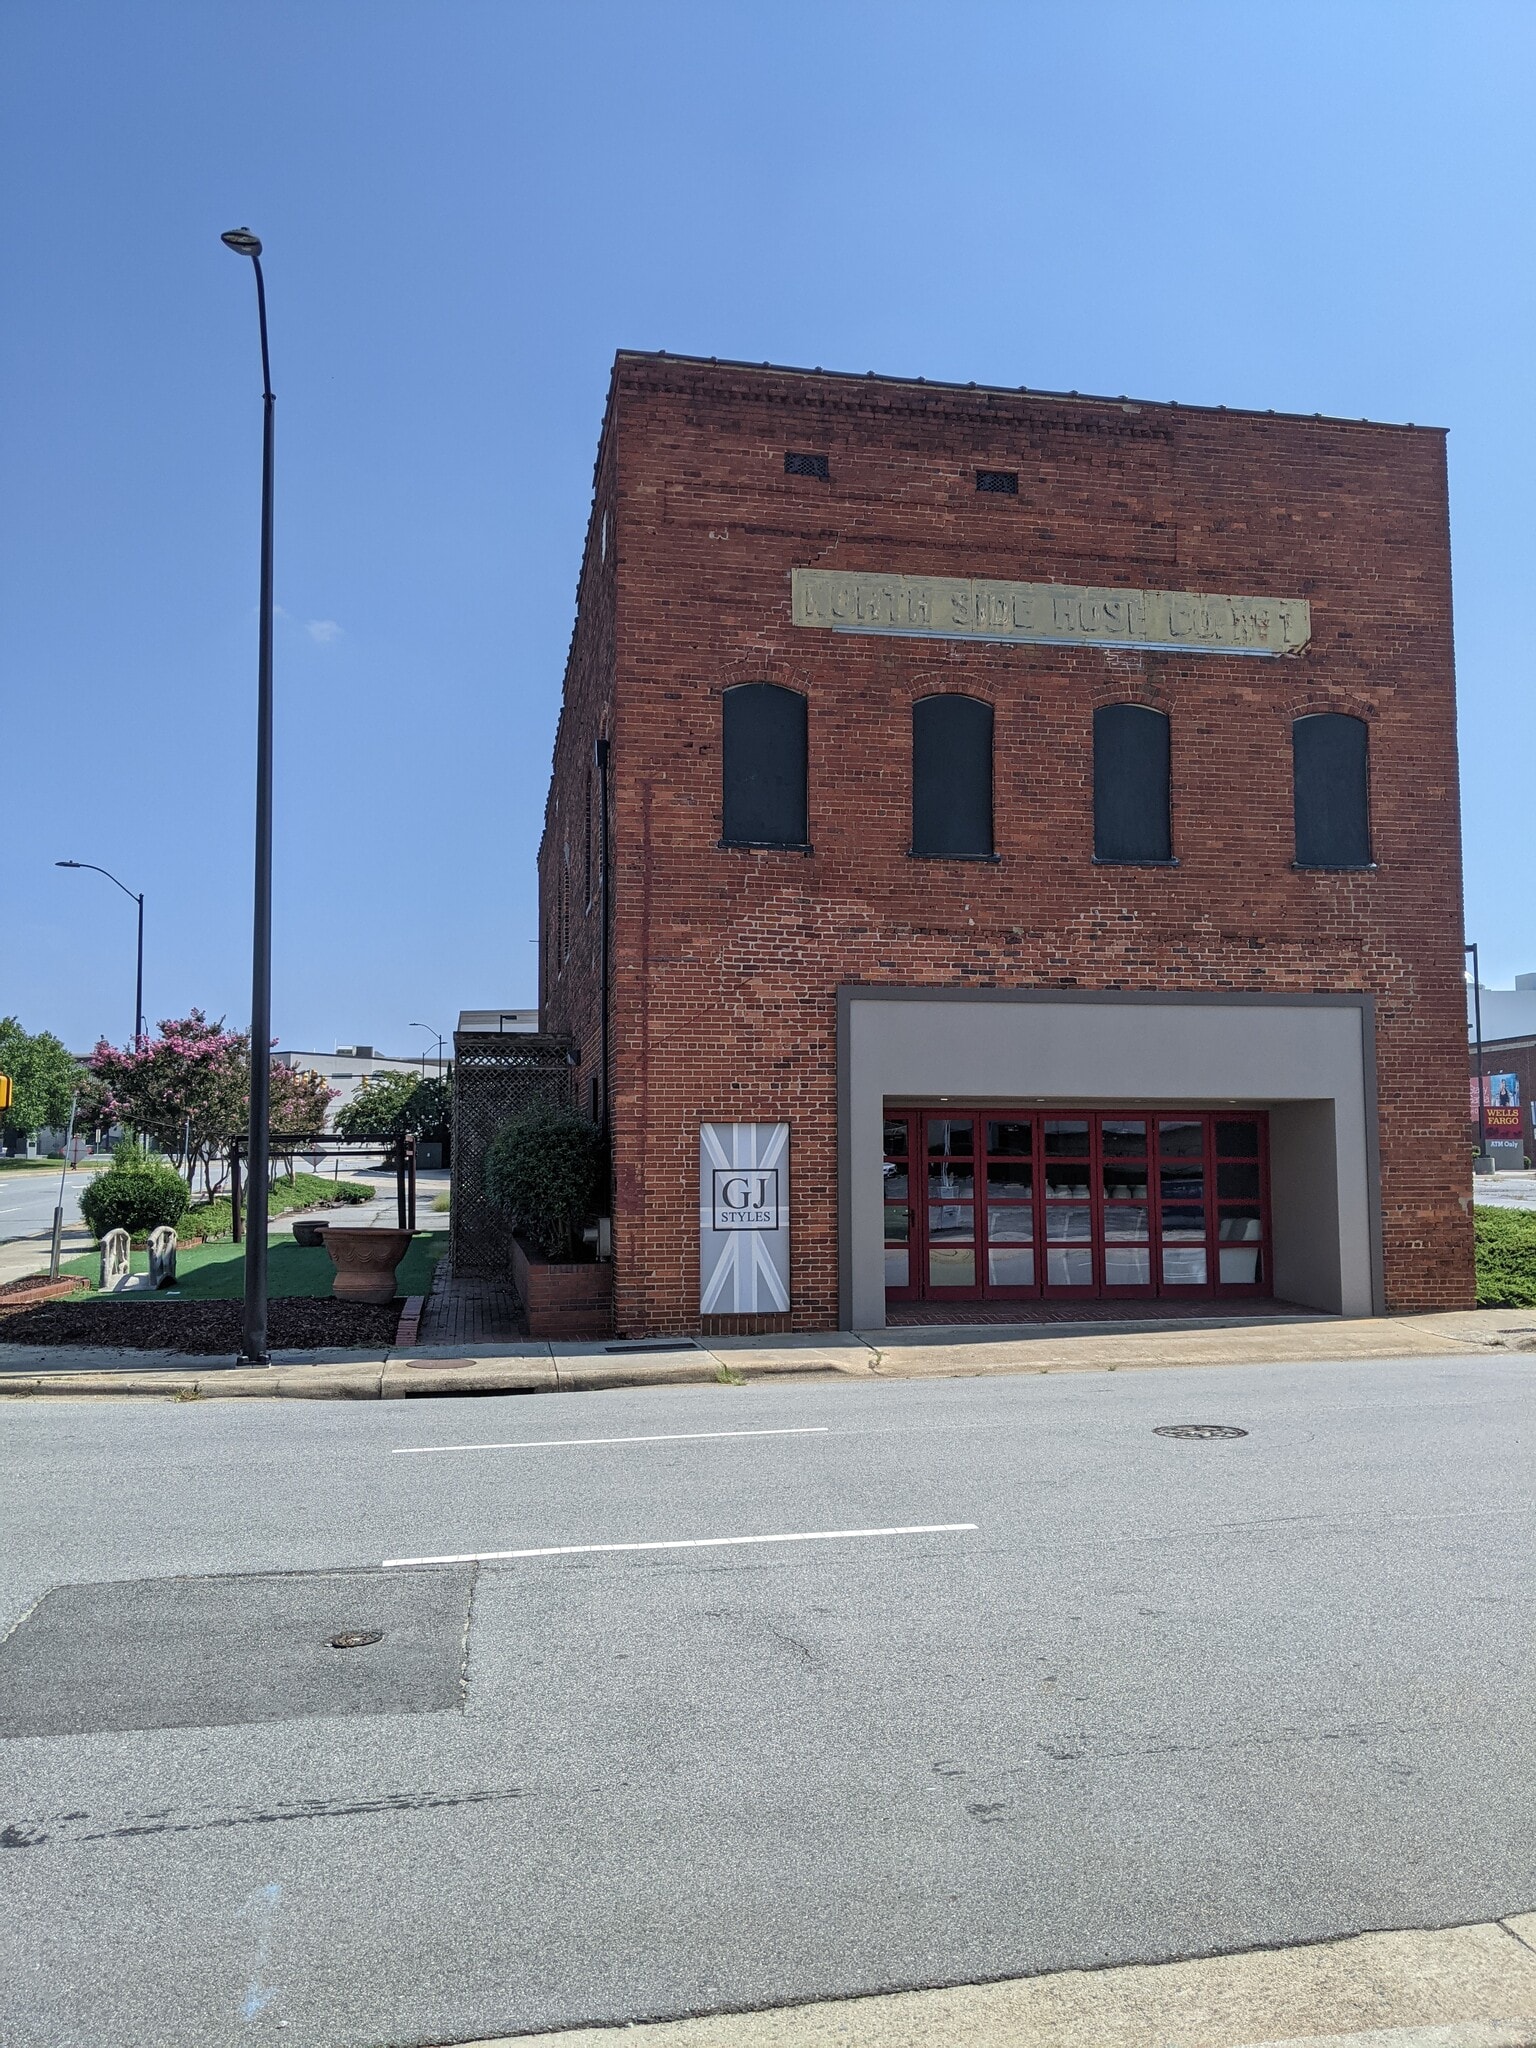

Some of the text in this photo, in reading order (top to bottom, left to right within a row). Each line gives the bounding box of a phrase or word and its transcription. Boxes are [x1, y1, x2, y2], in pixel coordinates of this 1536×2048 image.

[950, 591, 1035, 629] SIDE
[1052, 598, 1147, 635] HOSE
[1487, 1109, 1519, 1117] WELLS
[1488, 1117, 1519, 1125] FARGO
[721, 1177, 769, 1210] GJ
[721, 1211, 771, 1223] STYLES
